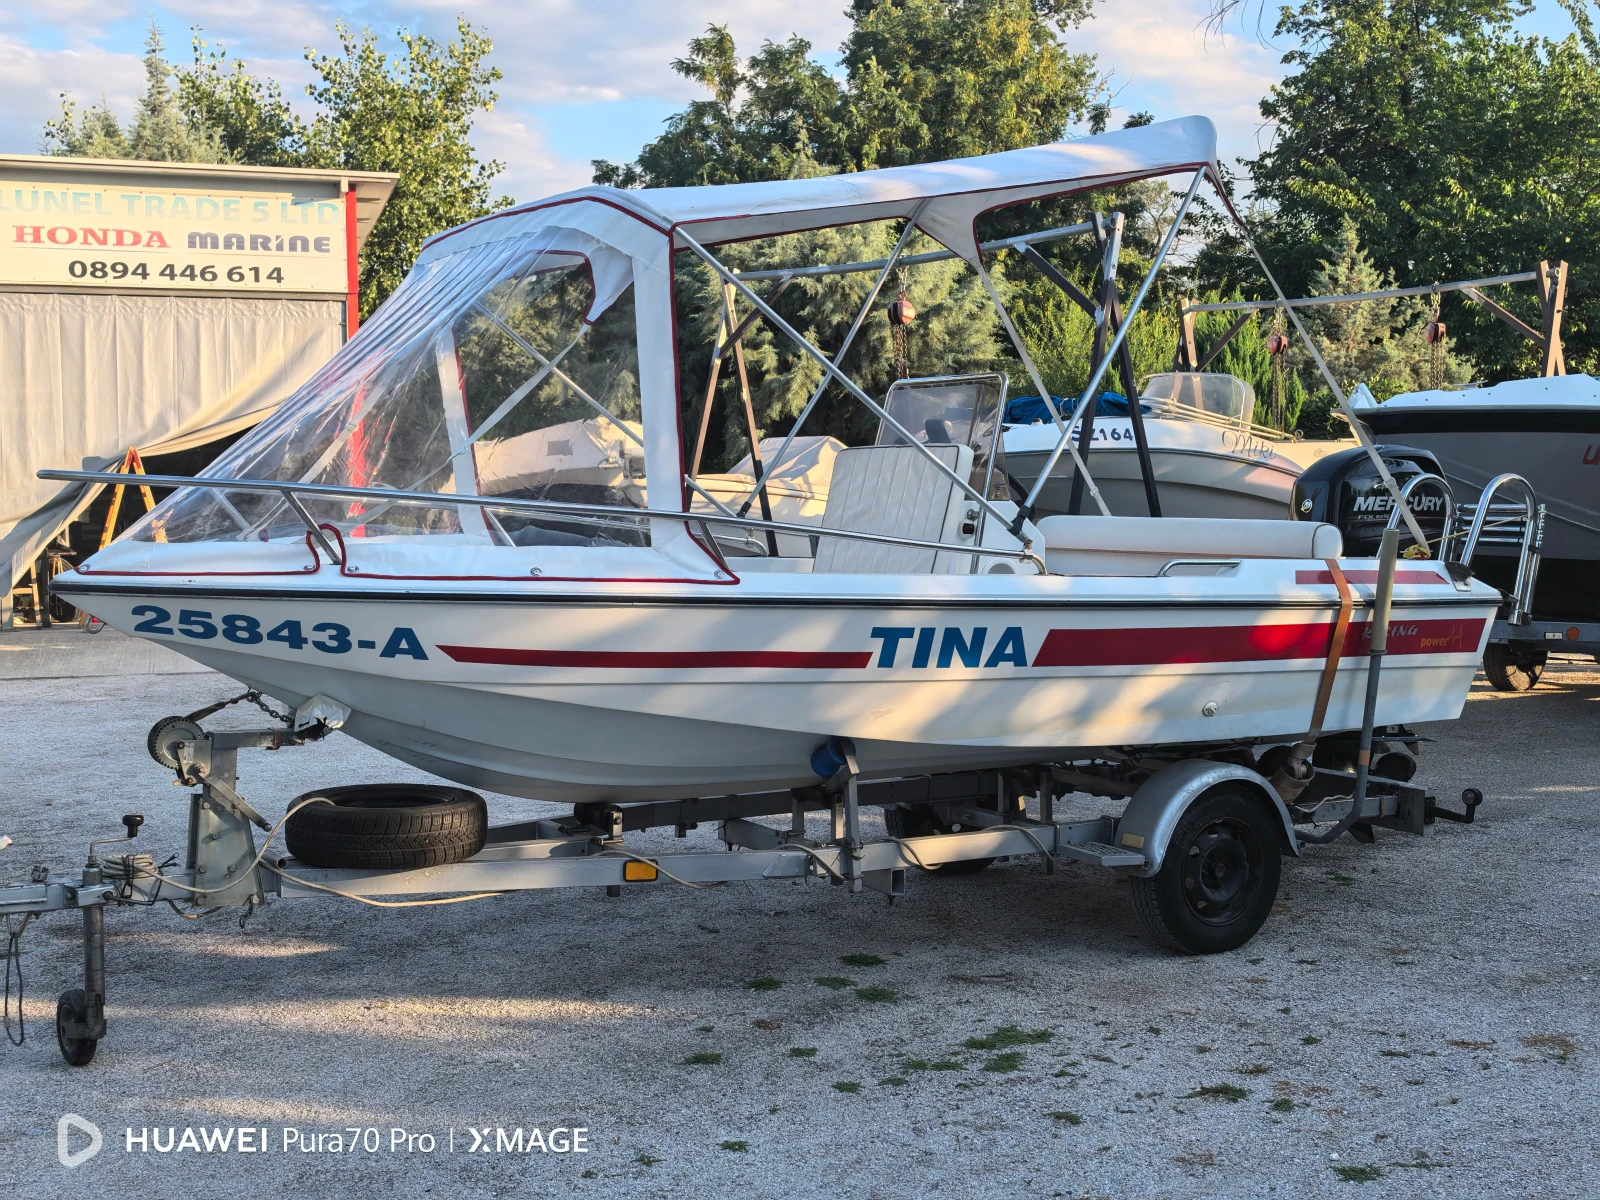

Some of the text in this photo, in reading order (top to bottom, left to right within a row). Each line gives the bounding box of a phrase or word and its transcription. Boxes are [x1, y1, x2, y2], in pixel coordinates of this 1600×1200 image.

[0, 189, 341, 225] LUNEL TRADE 5 LTD
[12, 225, 331, 253] HONDA MARINE
[68, 260, 285, 284] 0894 446 614
[1221, 430, 1277, 460] Miki
[131, 604, 430, 661] 25843-A
[870, 626, 1028, 668] TINA
[1420, 636, 1450, 649] power
